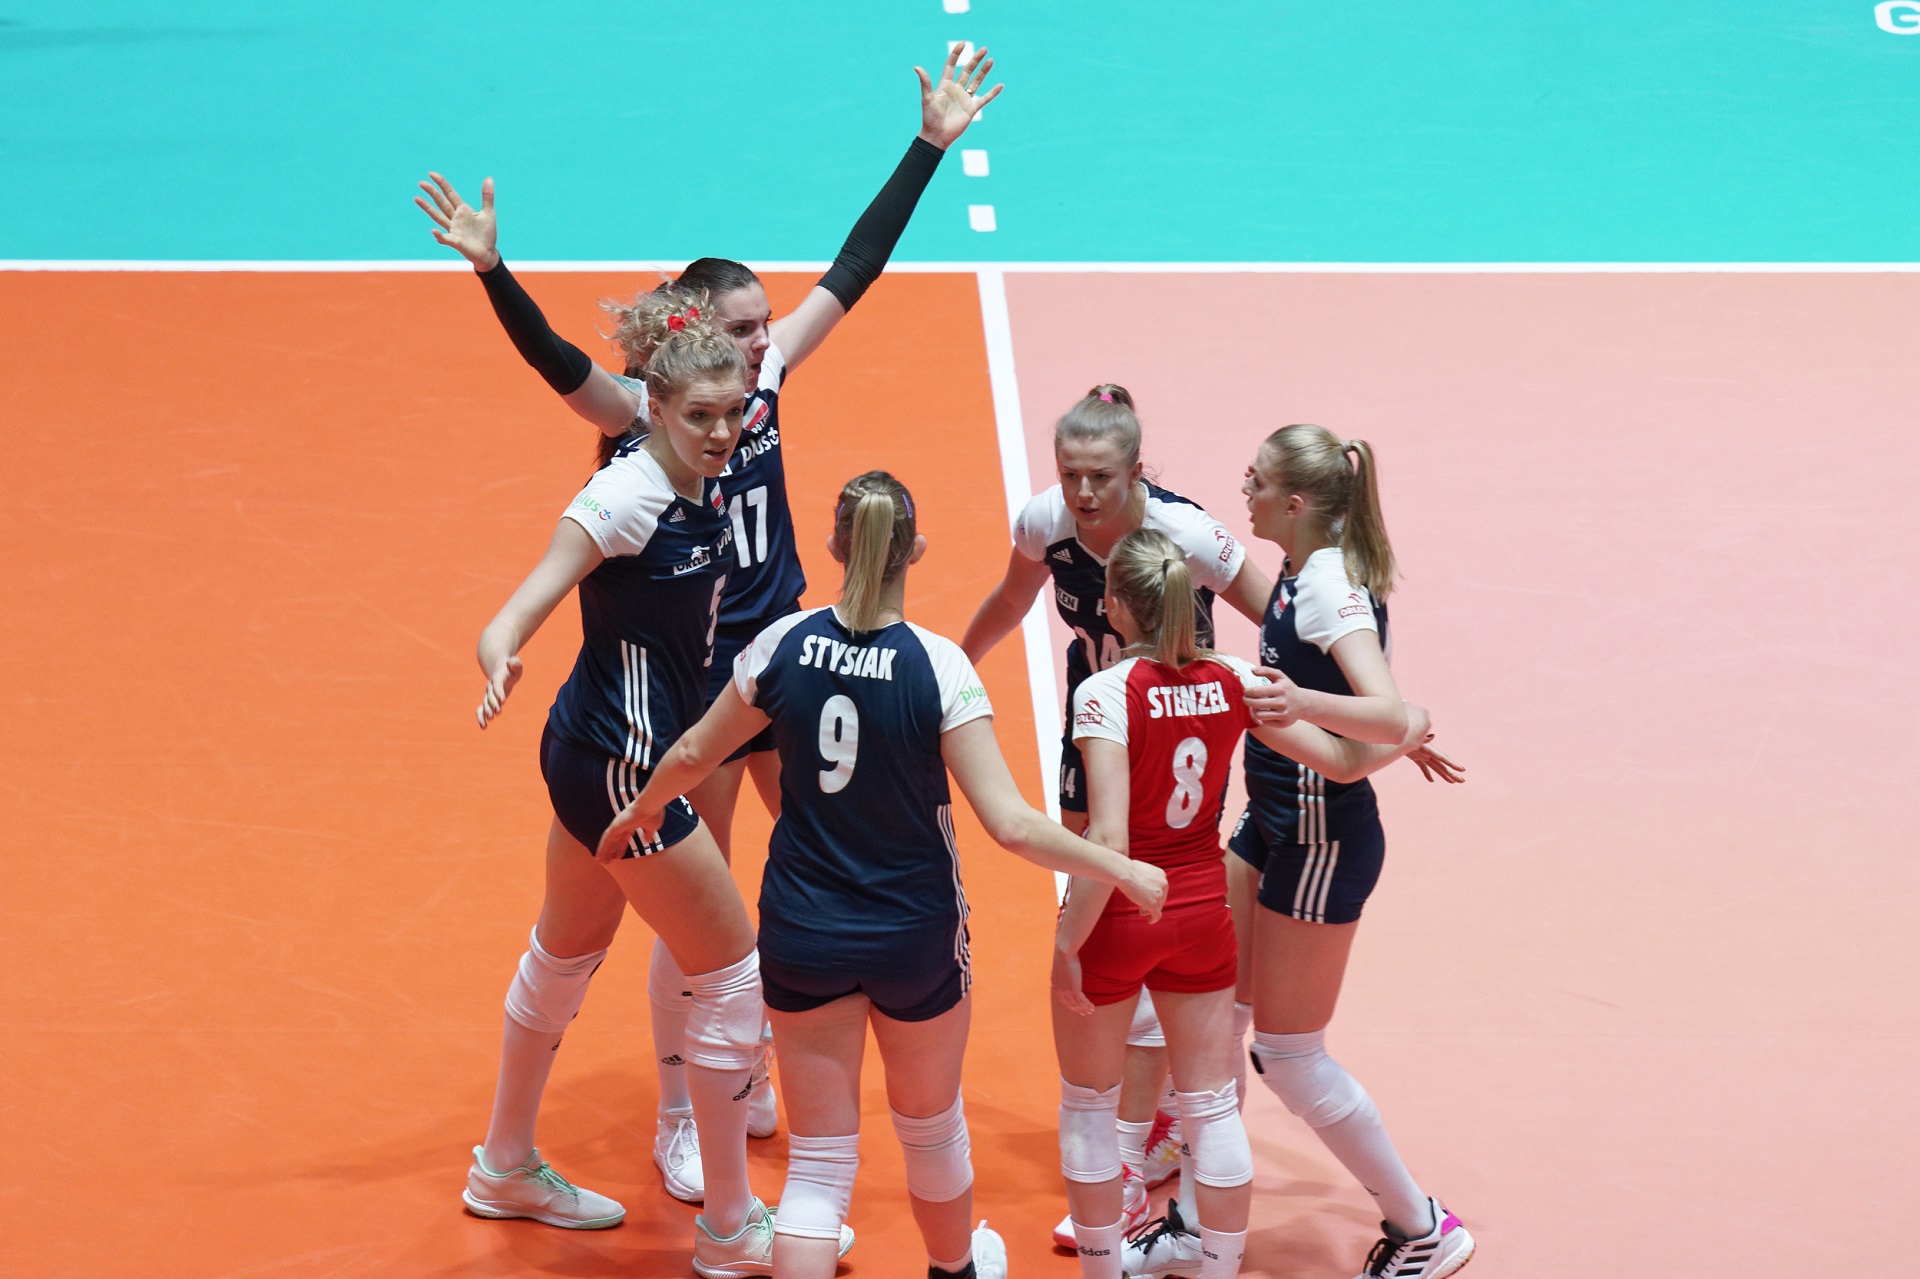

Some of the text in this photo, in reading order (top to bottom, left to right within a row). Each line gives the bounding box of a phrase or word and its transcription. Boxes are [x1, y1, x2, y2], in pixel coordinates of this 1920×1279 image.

[740, 434, 772, 468] plus
[728, 485, 768, 569] 17
[799, 635, 897, 681] STYSIAK
[1073, 626, 1121, 674] 14
[1147, 681, 1230, 719] STENZEL
[818, 694, 860, 794] 9
[1060, 764, 1077, 798] 14
[1165, 736, 1208, 829] 8
